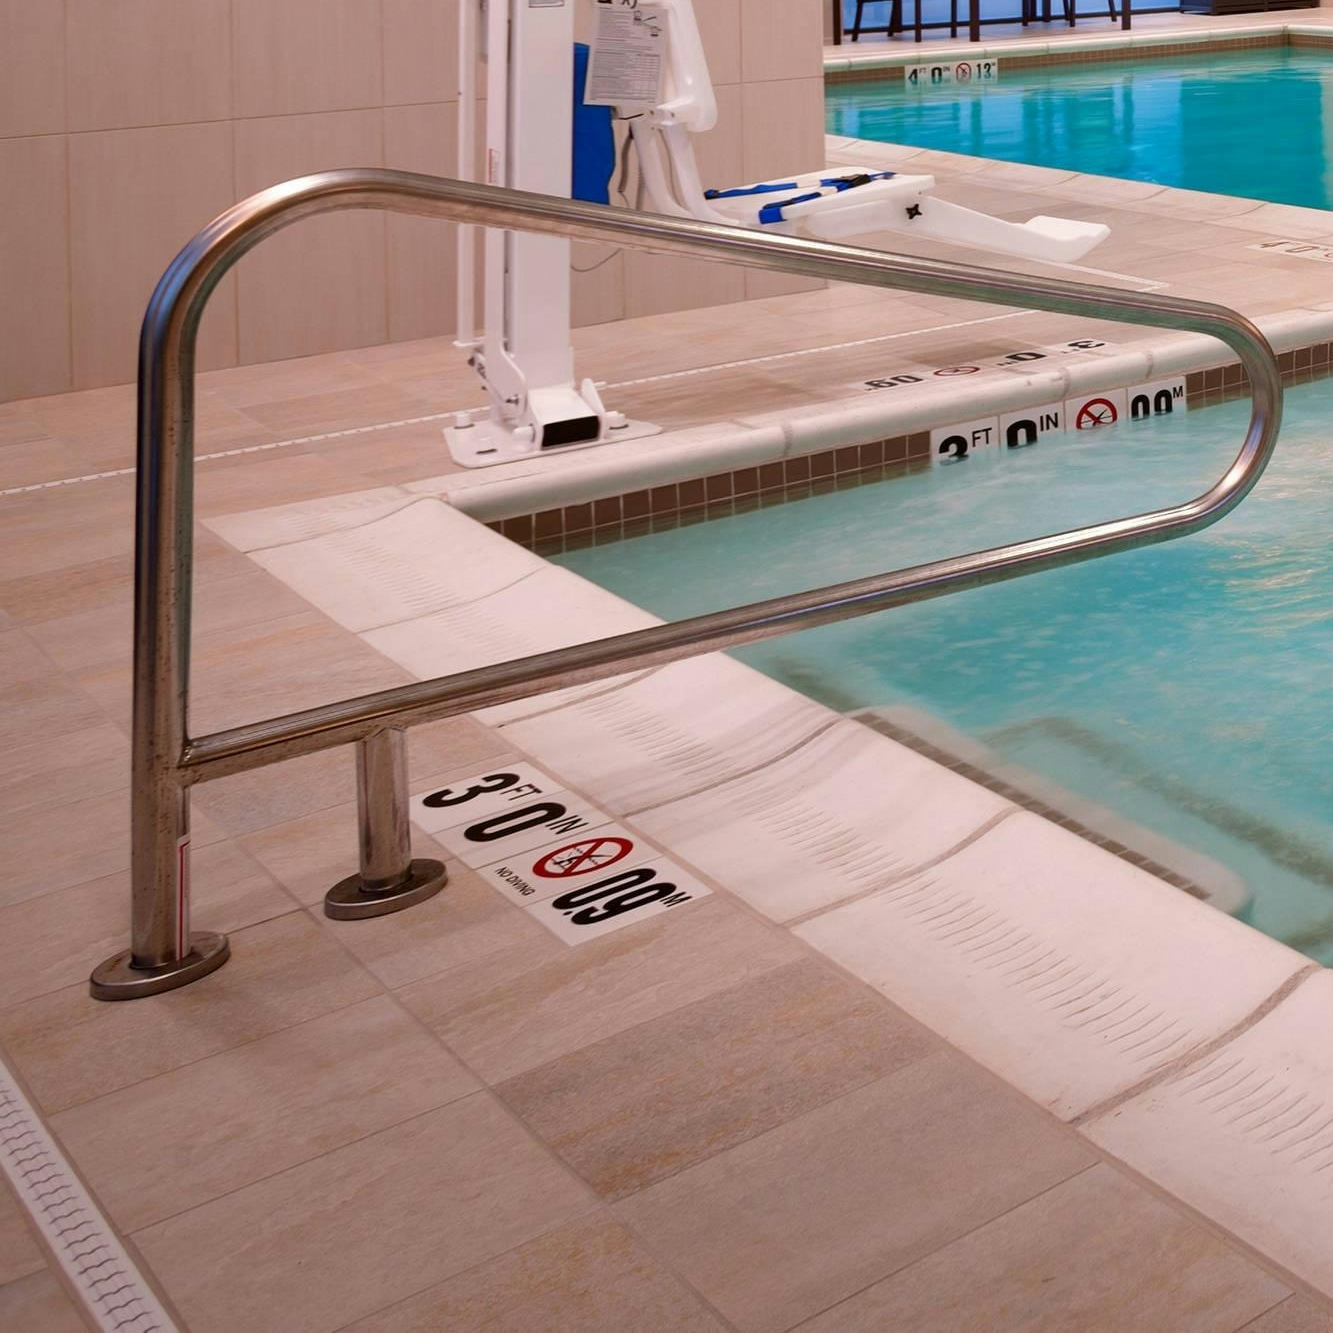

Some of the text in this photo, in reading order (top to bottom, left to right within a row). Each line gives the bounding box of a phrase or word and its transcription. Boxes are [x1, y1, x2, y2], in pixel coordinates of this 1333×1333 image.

[972, 427, 992, 447] FT
[1040, 412, 1058, 432] IN
[422, 773, 520, 808] 3
[501, 783, 543, 801] FT
[464, 802, 567, 842] 0
[545, 814, 589, 835] IN
[494, 866, 536, 896] NO DIVING
